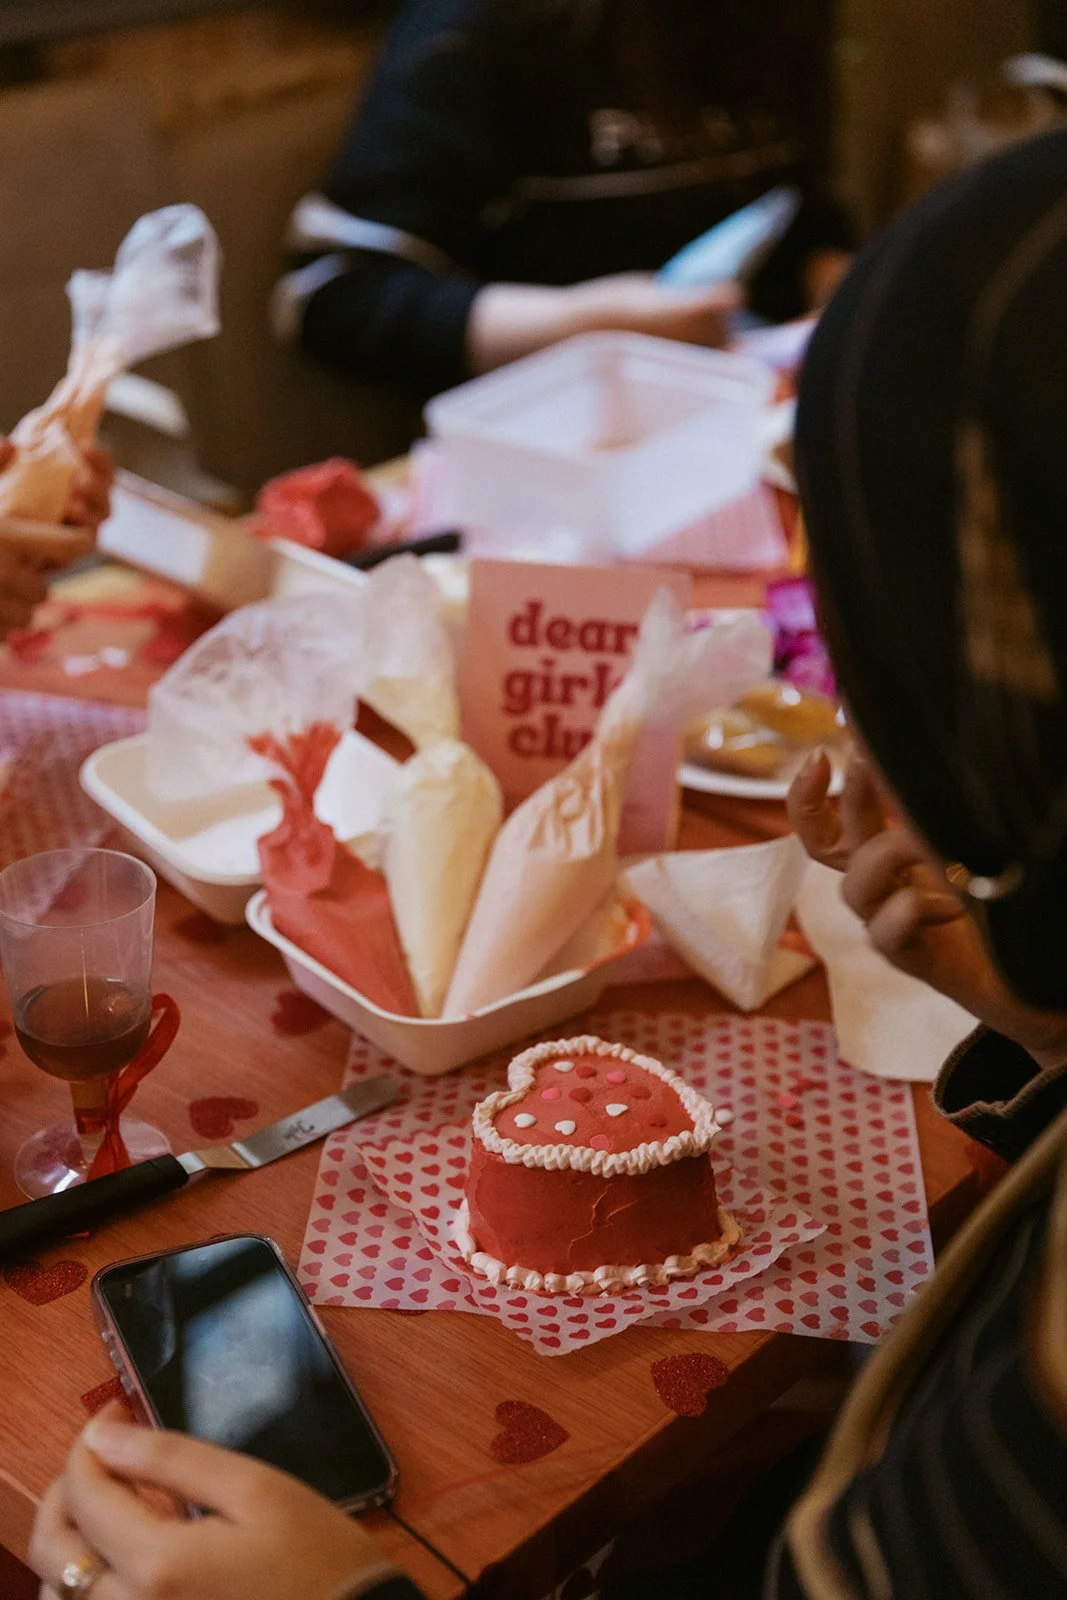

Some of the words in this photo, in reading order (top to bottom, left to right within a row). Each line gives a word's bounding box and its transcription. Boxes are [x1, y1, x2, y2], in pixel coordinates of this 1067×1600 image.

[508, 600, 639, 655] dear
[503, 657, 624, 716] girl
[507, 712, 595, 760] clu
